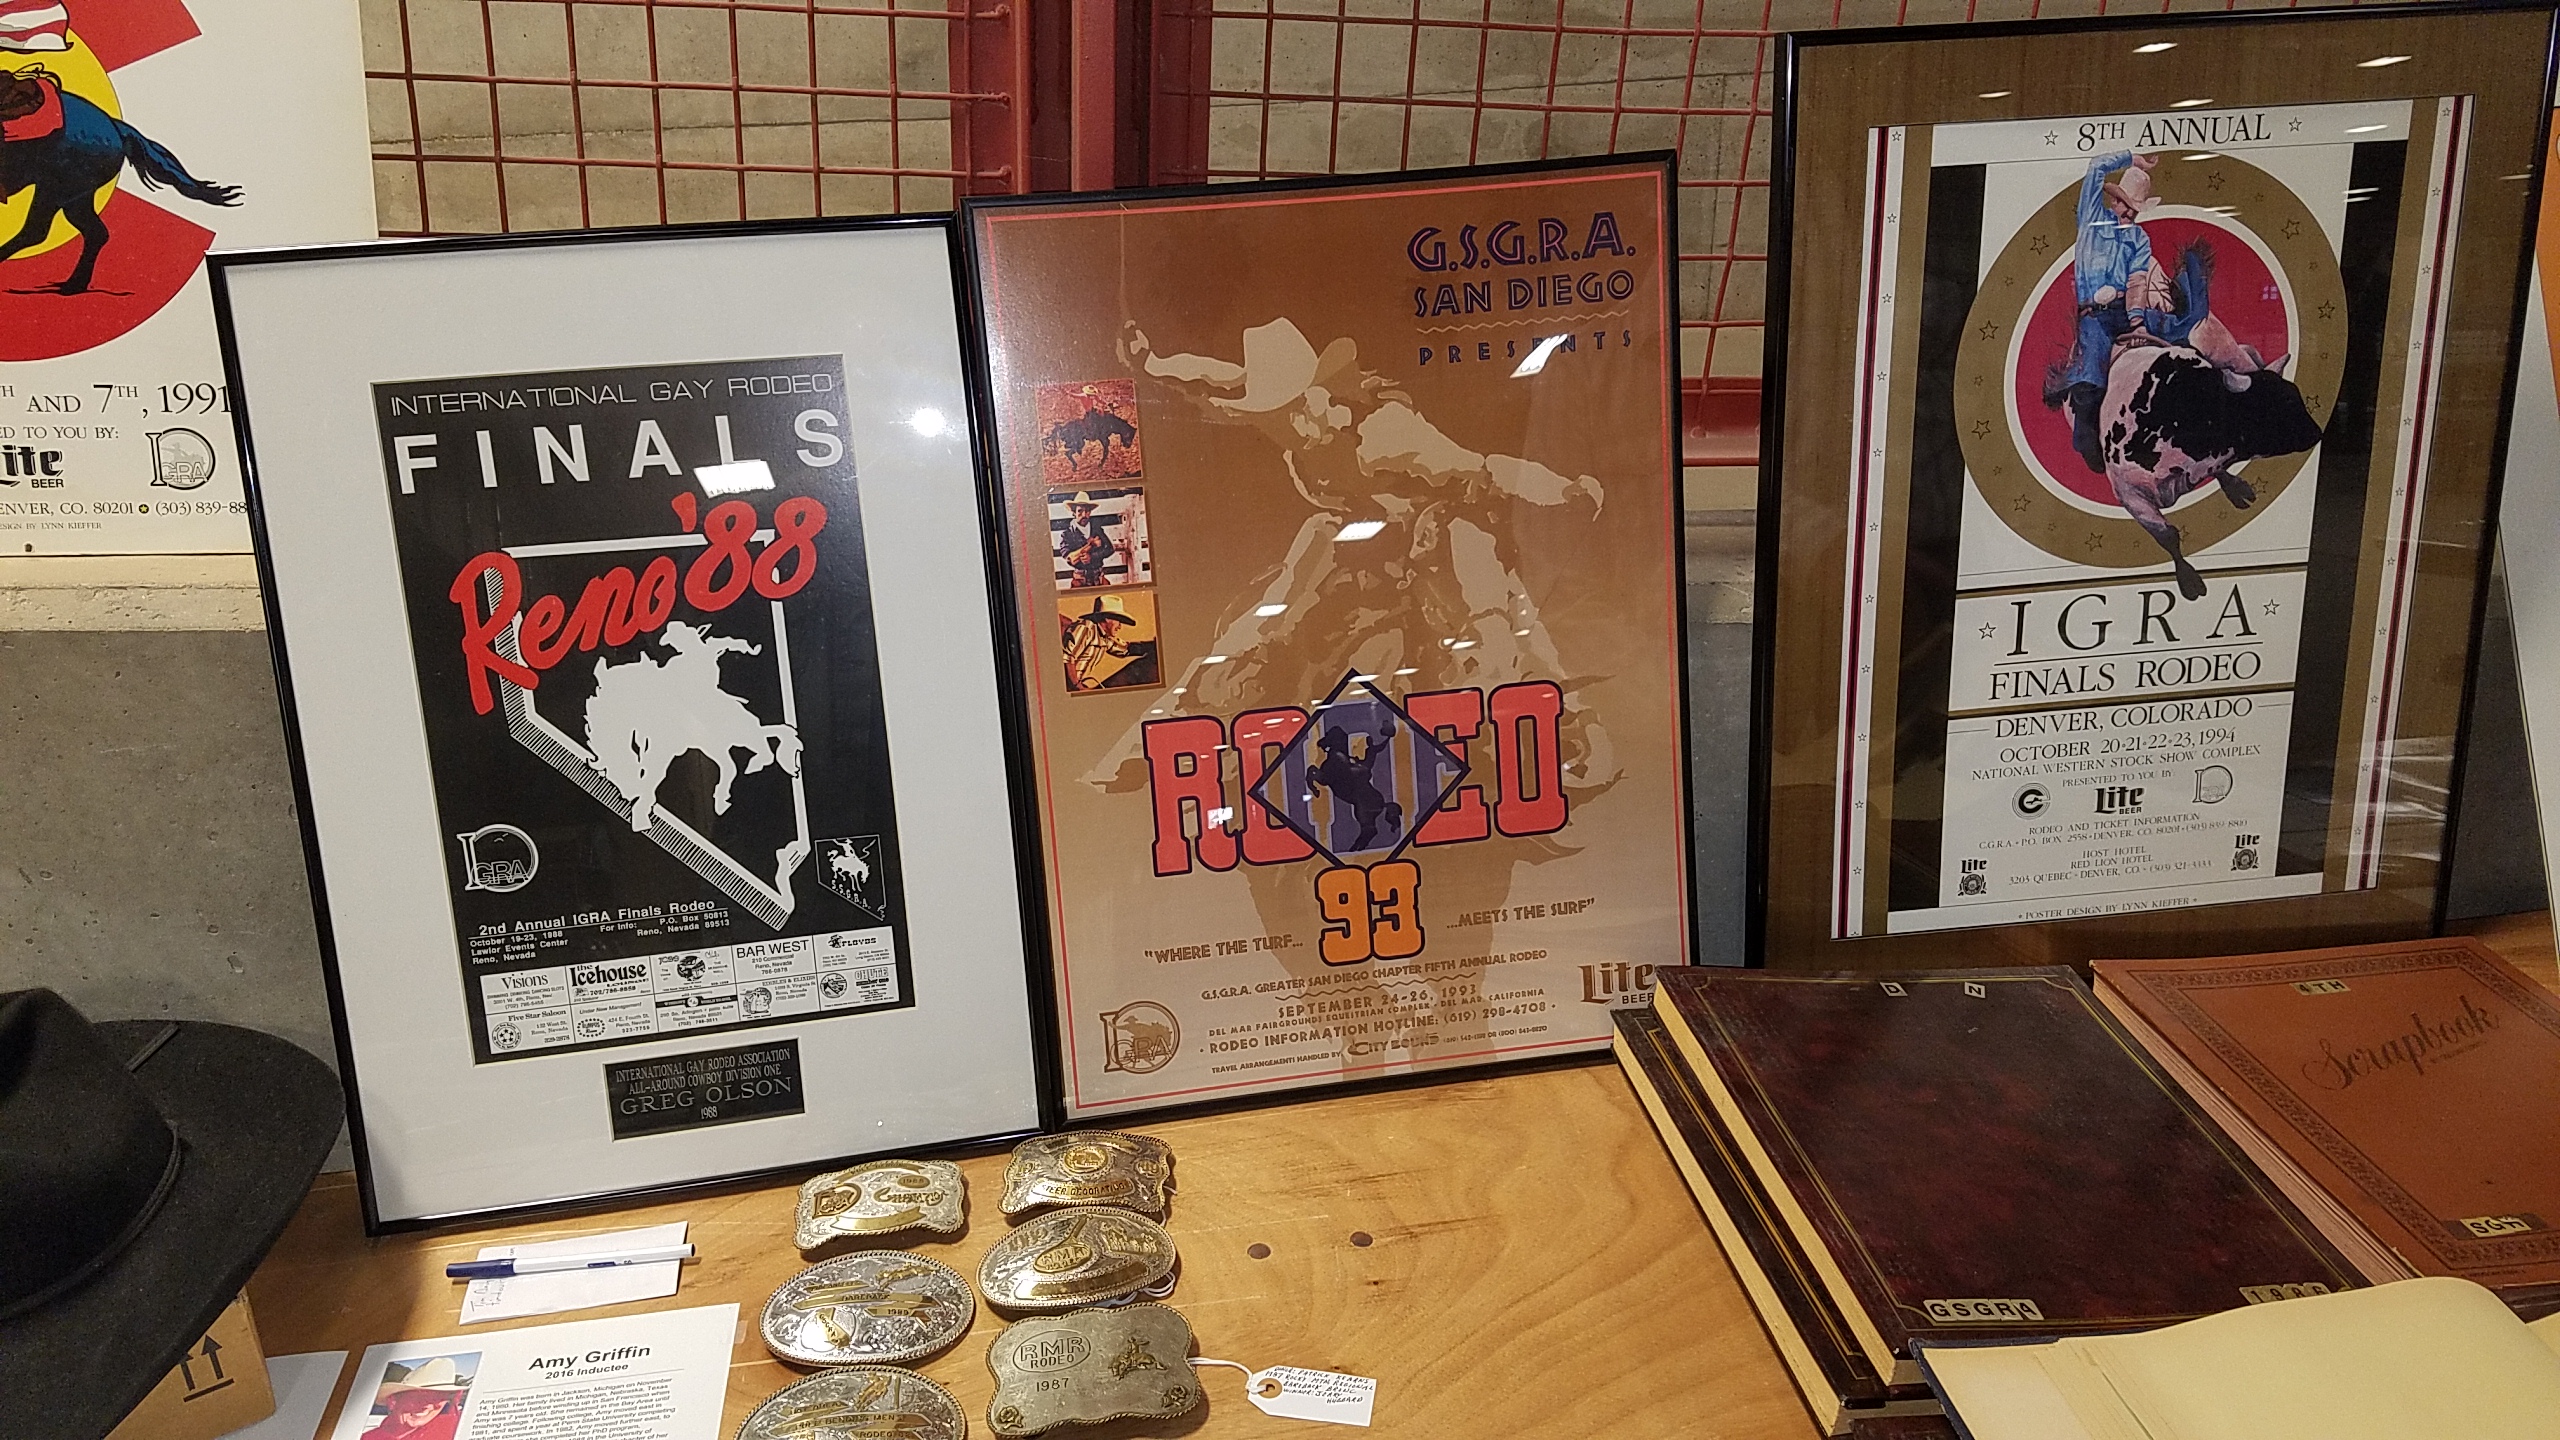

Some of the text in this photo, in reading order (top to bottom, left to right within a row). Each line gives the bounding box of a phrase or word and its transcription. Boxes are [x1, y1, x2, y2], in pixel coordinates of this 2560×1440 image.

[2076, 113, 2272, 152] 8TH ANNUAL
[1407, 211, 1637, 272] G.S.G.R.A.
[1414, 269, 1634, 318] SAN DIEGO
[26, 395, 81, 413] AND
[157, 383, 232, 414] 1991
[391, 373, 832, 416] INTERNATIONAL GAY RODEO
[23, 427, 120, 439] TO YOU BY:
[393, 409, 844, 495] FINALS
[31, 478, 64, 489] BEER
[60, 502, 88, 515] CO.
[93, 502, 134, 515] 80201
[155, 501, 192, 517] (303)
[26, 522, 102, 530] BY LYNN KIEFFER
[449, 551, 677, 715] Reno
[1988, 651, 2262, 701] FINALS RODEO
[1995, 697, 2253, 739] DENVER, COLORADO
[1999, 741, 2091, 763] OCTOBER
[2199, 725, 2236, 746] 1994
[1972, 744, 2261, 781] NATIONAL WESTERN STOCK SHOW COMPLEX
[1141, 679, 1571, 878] RODEO
[2062, 771, 2155, 787] PRESENTED TO YOU
[2094, 785, 2145, 814] Lite
[2119, 807, 2142, 815] BEER
[2029, 812, 2200, 836] RODEO AND TICKET INFORMATION
[2042, 836, 2062, 845] BOX
[2234, 834, 2260, 849] Lite
[2070, 855, 2154, 869] RED LION HOTEL
[2082, 846, 2147, 858] HOST HOTEL
[1960, 859, 1988, 874] Lite
[2033, 872, 2072, 884] QUEBEC
[479, 900, 715, 936] 2nd Annual IGRA Finals Rodeo
[1314, 858, 1425, 968] 93
[1514, 904, 1546, 921] THE
[2025, 898, 2190, 920] POSTER DESIGN BY LYNN KIEFFER
[600, 924, 614, 933] For
[617, 921, 637, 931] Info:
[660, 916, 678, 926] P.O.
[682, 914, 699, 923] Box
[637, 927, 663, 937] Reno,
[667, 923, 699, 933] Nevada
[470, 937, 505, 948] October
[511, 933, 537, 943] 19-23,
[505, 942, 535, 953] Events
[540, 938, 569, 949] Center
[736, 939, 809, 959] BAR WEST
[1216, 940, 1248, 956] THE
[472, 951, 536, 965] Reno, Nevada
[577, 964, 593, 972] the
[501, 972, 549, 990] Visions
[569, 963, 647, 987] Icehouse
[1201, 949, 1547, 1001] G.S.G.R.A. GREATER SAN DIEGO CHAPTER FIFTH ANNUAL RODEO
[1577, 961, 1656, 1006] Lite
[2299, 980, 2345, 994] 4TH
[1278, 983, 1477, 1018] SEPTEMBER 24-26, 1993
[508, 1009, 567, 1022] Five Star Saloon
[1208, 988, 1545, 1037] DEL MAR FAIRGROUNDS EQUESTRIAN COMPLEX DEL CALIFORNIA
[1210, 1037, 1259, 1054] RODEO
[1264, 1022, 1368, 1047] INFORMATION
[1373, 1014, 1440, 1033] HOTLINE:
[1443, 1010, 1477, 1025] (619)
[2301, 995, 2500, 1091] Scrapbook
[616, 1048, 791, 1083] INTERNATIONAL GAY RODEO ASSOCIATION
[1212, 1052, 1330, 1074] TRAVEL ARRANGEMENTS HANDLED
[629, 1064, 781, 1095] ALL-AROUND COWBOY DIVISION ONE
[620, 1076, 792, 1115] GREG OLSON
[701, 1105, 718, 1120] 1988
[1929, 1302, 2038, 1317] GSGRA
[528, 1345, 651, 1371] Amy Griffin
[1020, 1336, 1085, 1361] RMR
[545, 1363, 629, 1379] 2016 Inductee
[1030, 1354, 1075, 1369] RODEO
[1036, 1377, 1070, 1392] 1987
